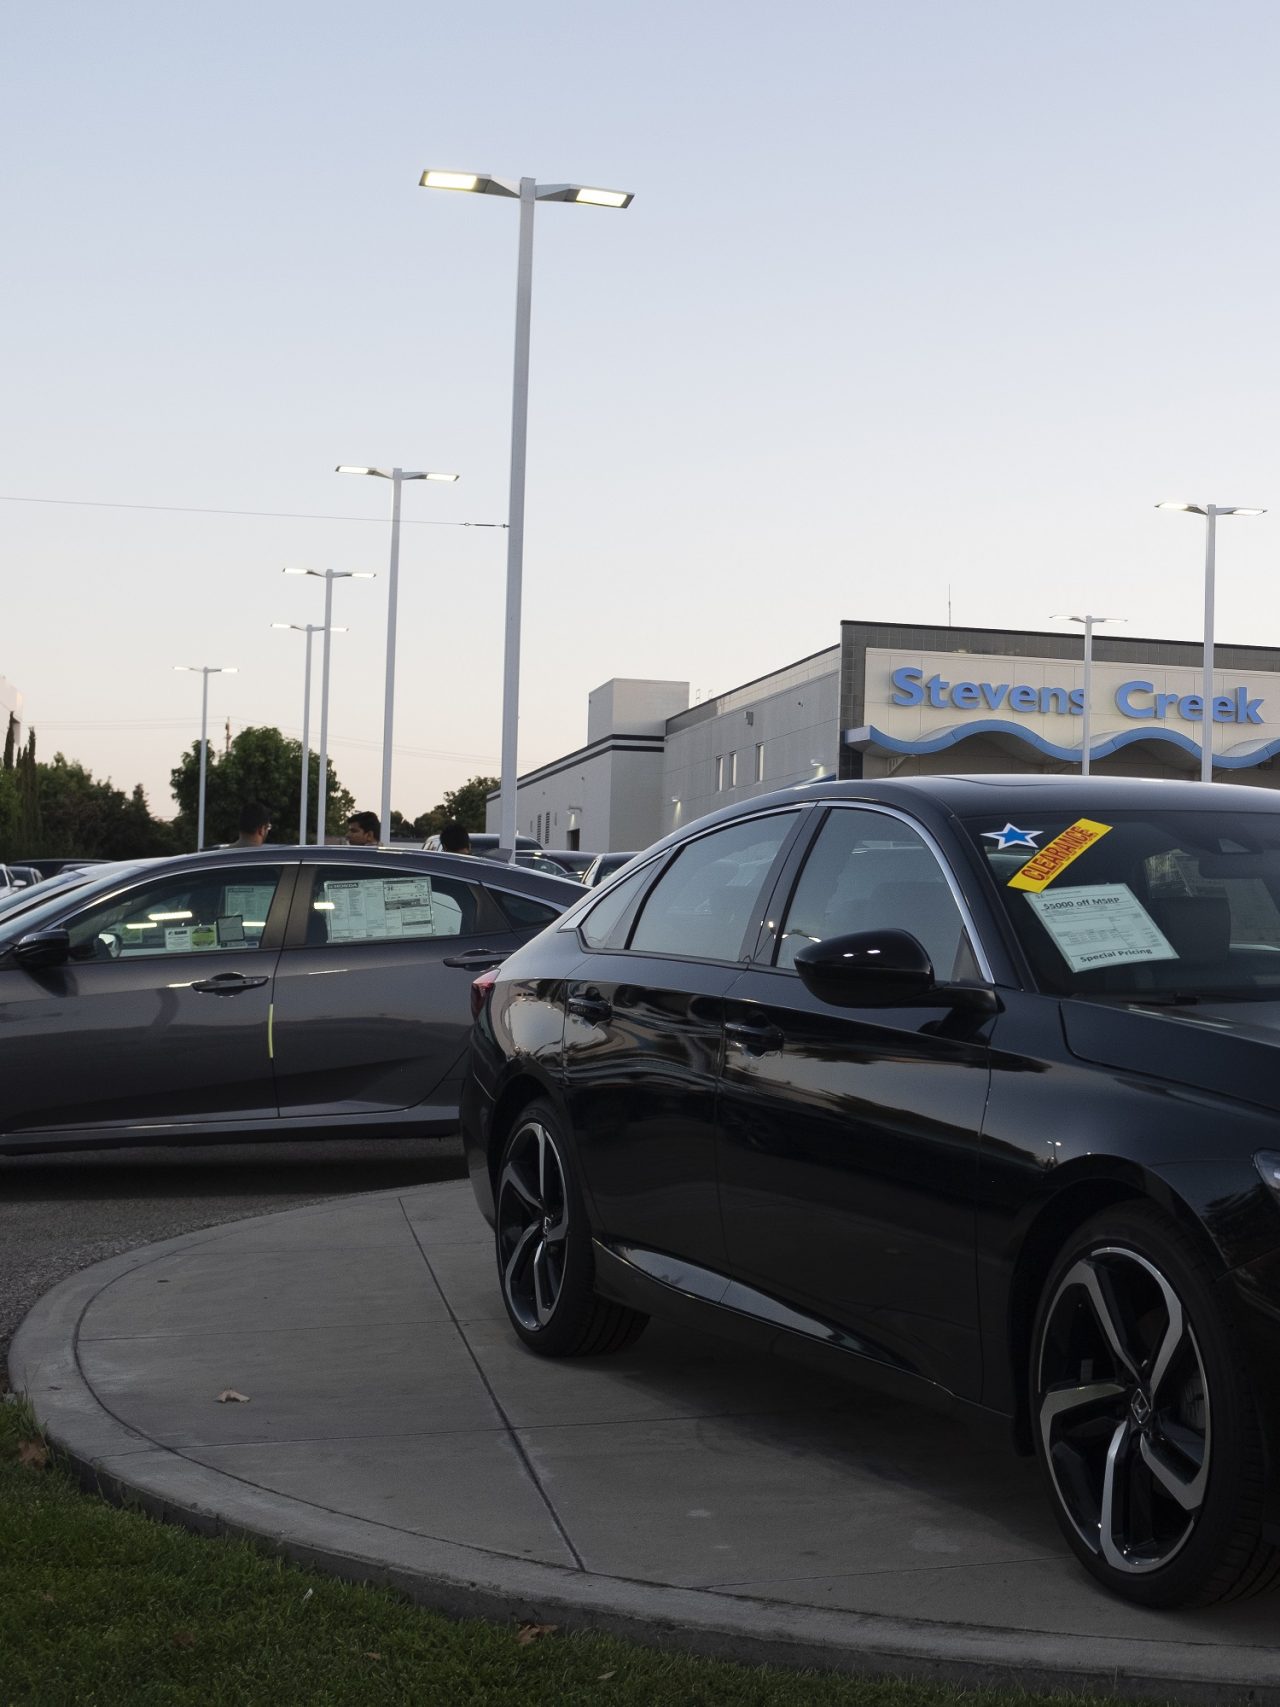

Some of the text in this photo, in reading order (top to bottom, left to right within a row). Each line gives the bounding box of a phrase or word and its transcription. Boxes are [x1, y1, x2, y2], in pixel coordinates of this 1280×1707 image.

[891, 666, 1265, 725] Stevens Creek
[1021, 826, 1096, 881] CLEARANCE
[1091, 897, 1120, 905] MSRP
[1080, 947, 1153, 963] Special Pricing
